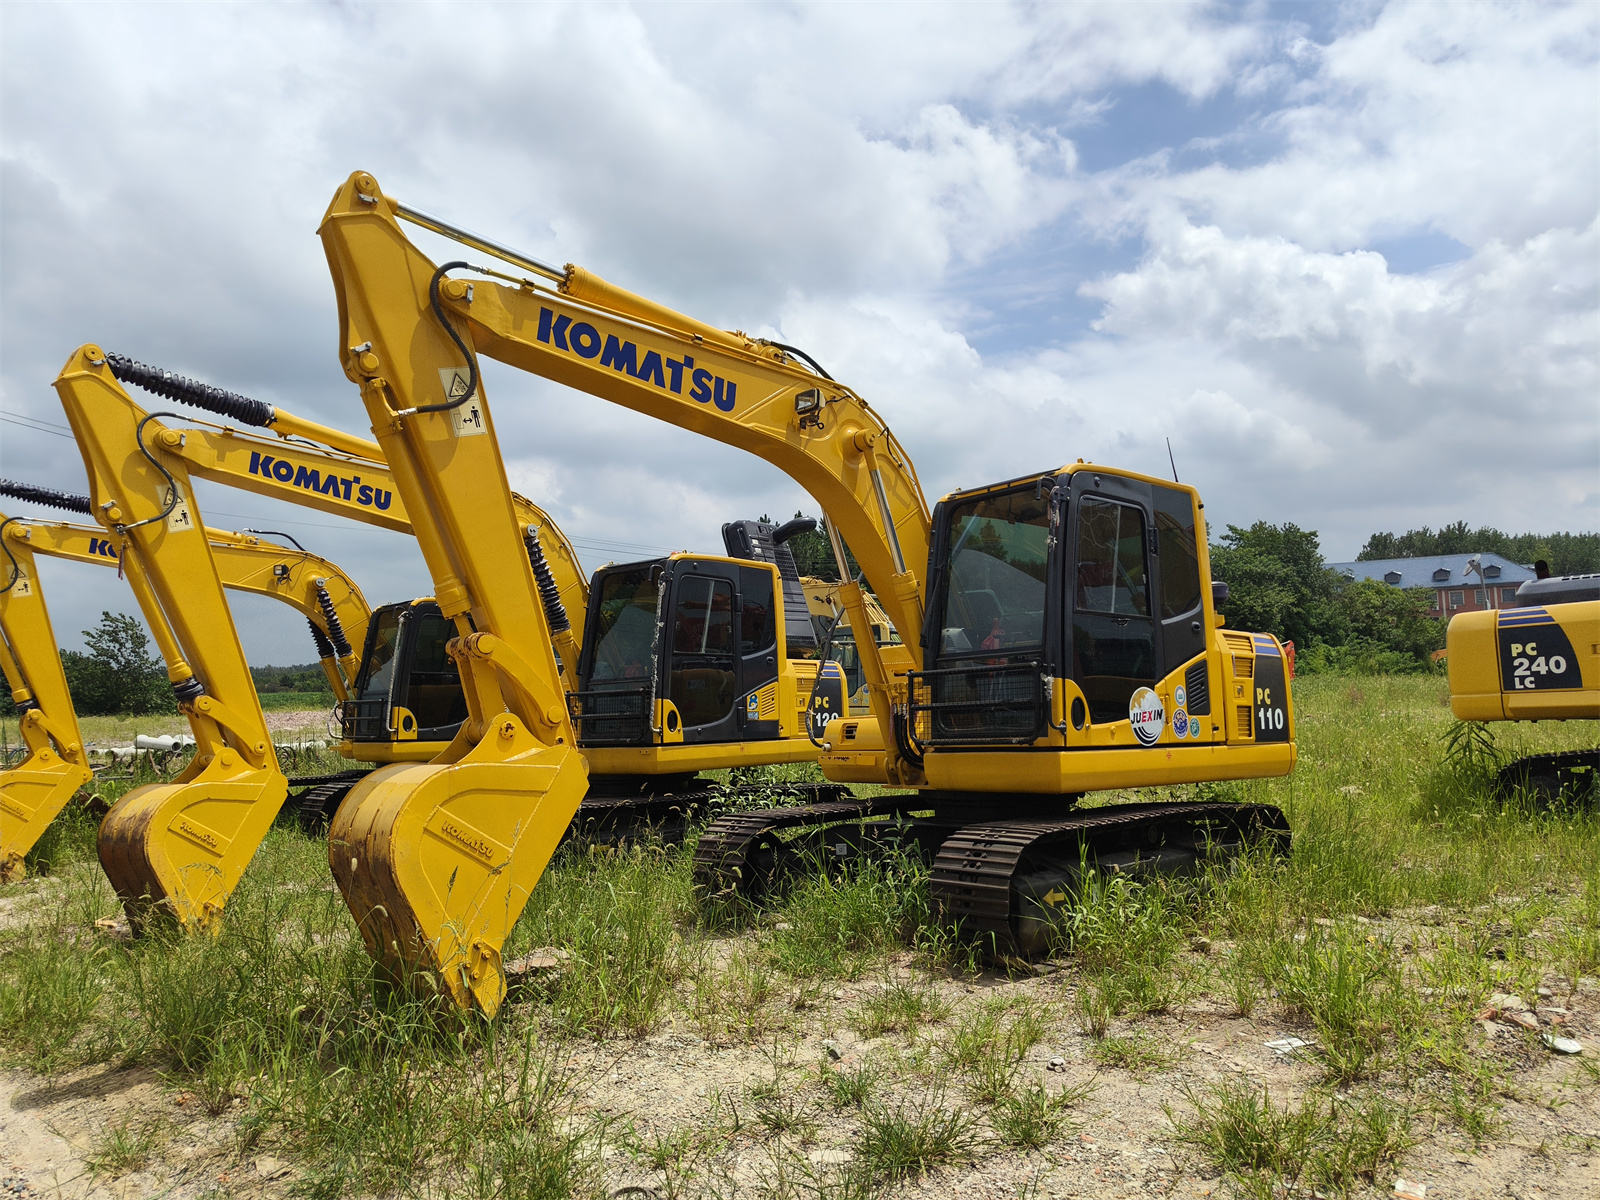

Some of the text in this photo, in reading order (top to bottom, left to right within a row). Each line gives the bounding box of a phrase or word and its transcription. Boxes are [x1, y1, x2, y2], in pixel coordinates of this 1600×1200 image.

[537, 306, 737, 413] KOMATSU
[248, 450, 392, 511] KOMATSU
[1510, 642, 1538, 657] PC
[1513, 655, 1567, 676] 240
[1514, 676, 1536, 689] LC
[814, 696, 829, 709] PC
[1256, 687, 1271, 705] PC
[1130, 708, 1164, 725] JUEXIN
[1258, 707, 1284, 730] 110
